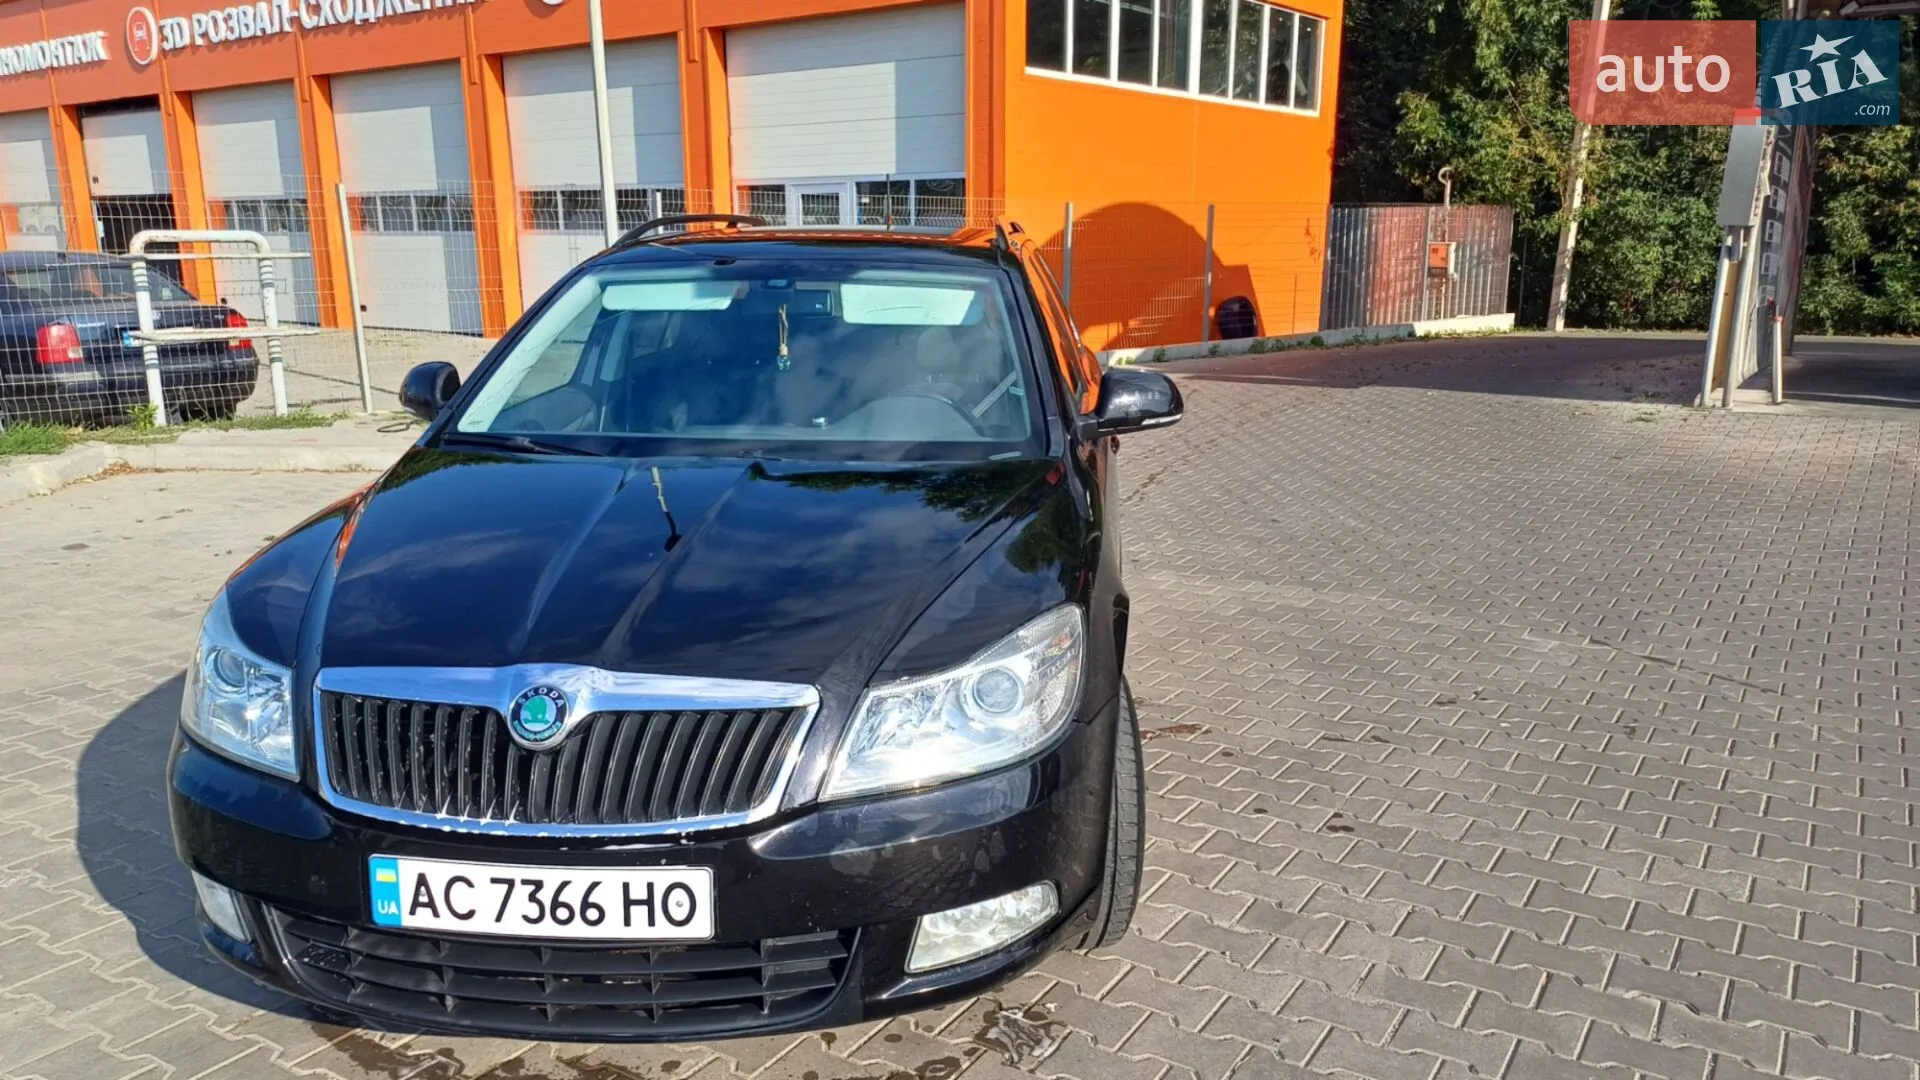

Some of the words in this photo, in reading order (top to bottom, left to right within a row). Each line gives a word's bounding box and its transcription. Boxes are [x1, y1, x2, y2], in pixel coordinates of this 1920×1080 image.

[159, 17, 191, 50] 3D
[191, 0, 478, 46] РОЗВАЛ-СХОД
[377, 899, 399, 916] UA
[408, 872, 477, 921] AC
[489, 877, 607, 927] 7366
[622, 881, 698, 928] HO
